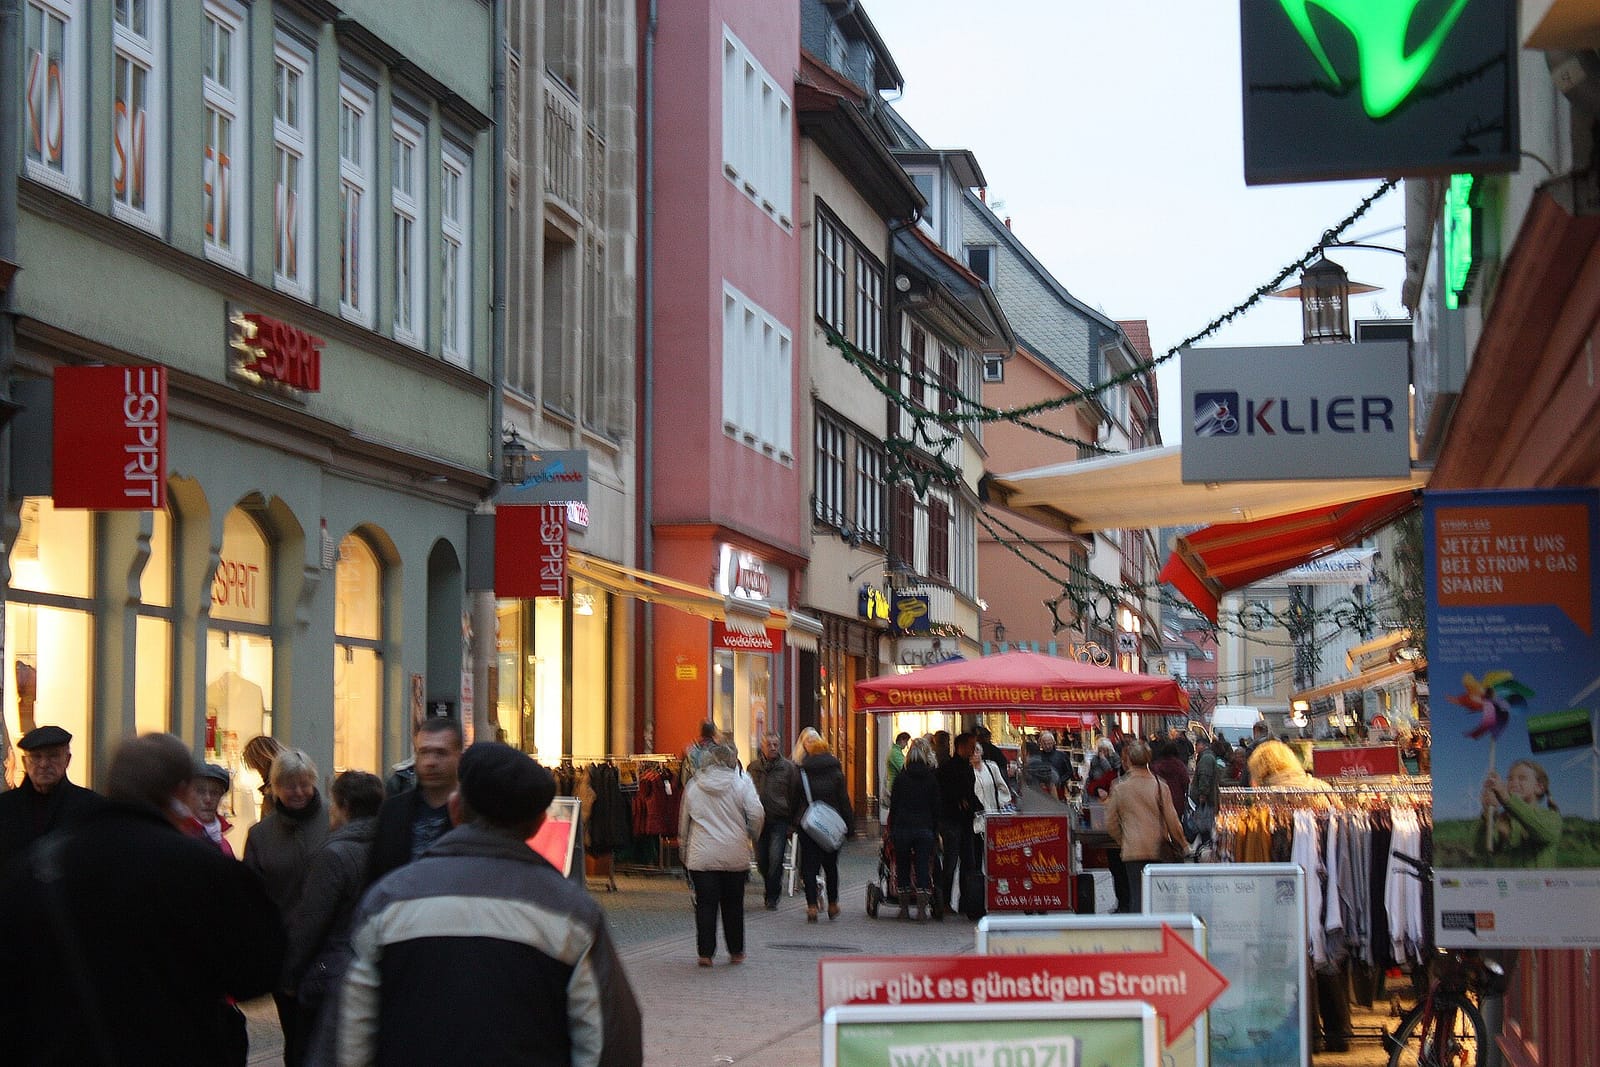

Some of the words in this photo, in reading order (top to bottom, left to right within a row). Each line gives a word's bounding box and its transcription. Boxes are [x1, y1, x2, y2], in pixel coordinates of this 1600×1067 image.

[241, 312, 327, 393] ESPRIT
[1246, 396, 1394, 436] KLIER
[124, 367, 159, 507] ESPRIT
[540, 506, 563, 597] ESPRIT
[1440, 537, 1490, 555] JETZT
[1495, 535, 1528, 553] MIT
[1533, 534, 1565, 552] UNS
[1441, 557, 1471, 574] BEI
[1476, 555, 1529, 573] STROM
[1545, 554, 1578, 573] GAS
[1442, 576, 1504, 594] SPAREN
[723, 634, 773, 649] vodafone
[888, 687, 953, 706] Original
[959, 685, 1036, 703] Thüringer
[1041, 685, 1122, 703] Bratwurst
[1156, 880, 1182, 894] Wir
[886, 973, 935, 1004] gibt
[937, 978, 968, 999] es
[972, 970, 1095, 1003] günstigen
[1099, 970, 1187, 996] Strom!
